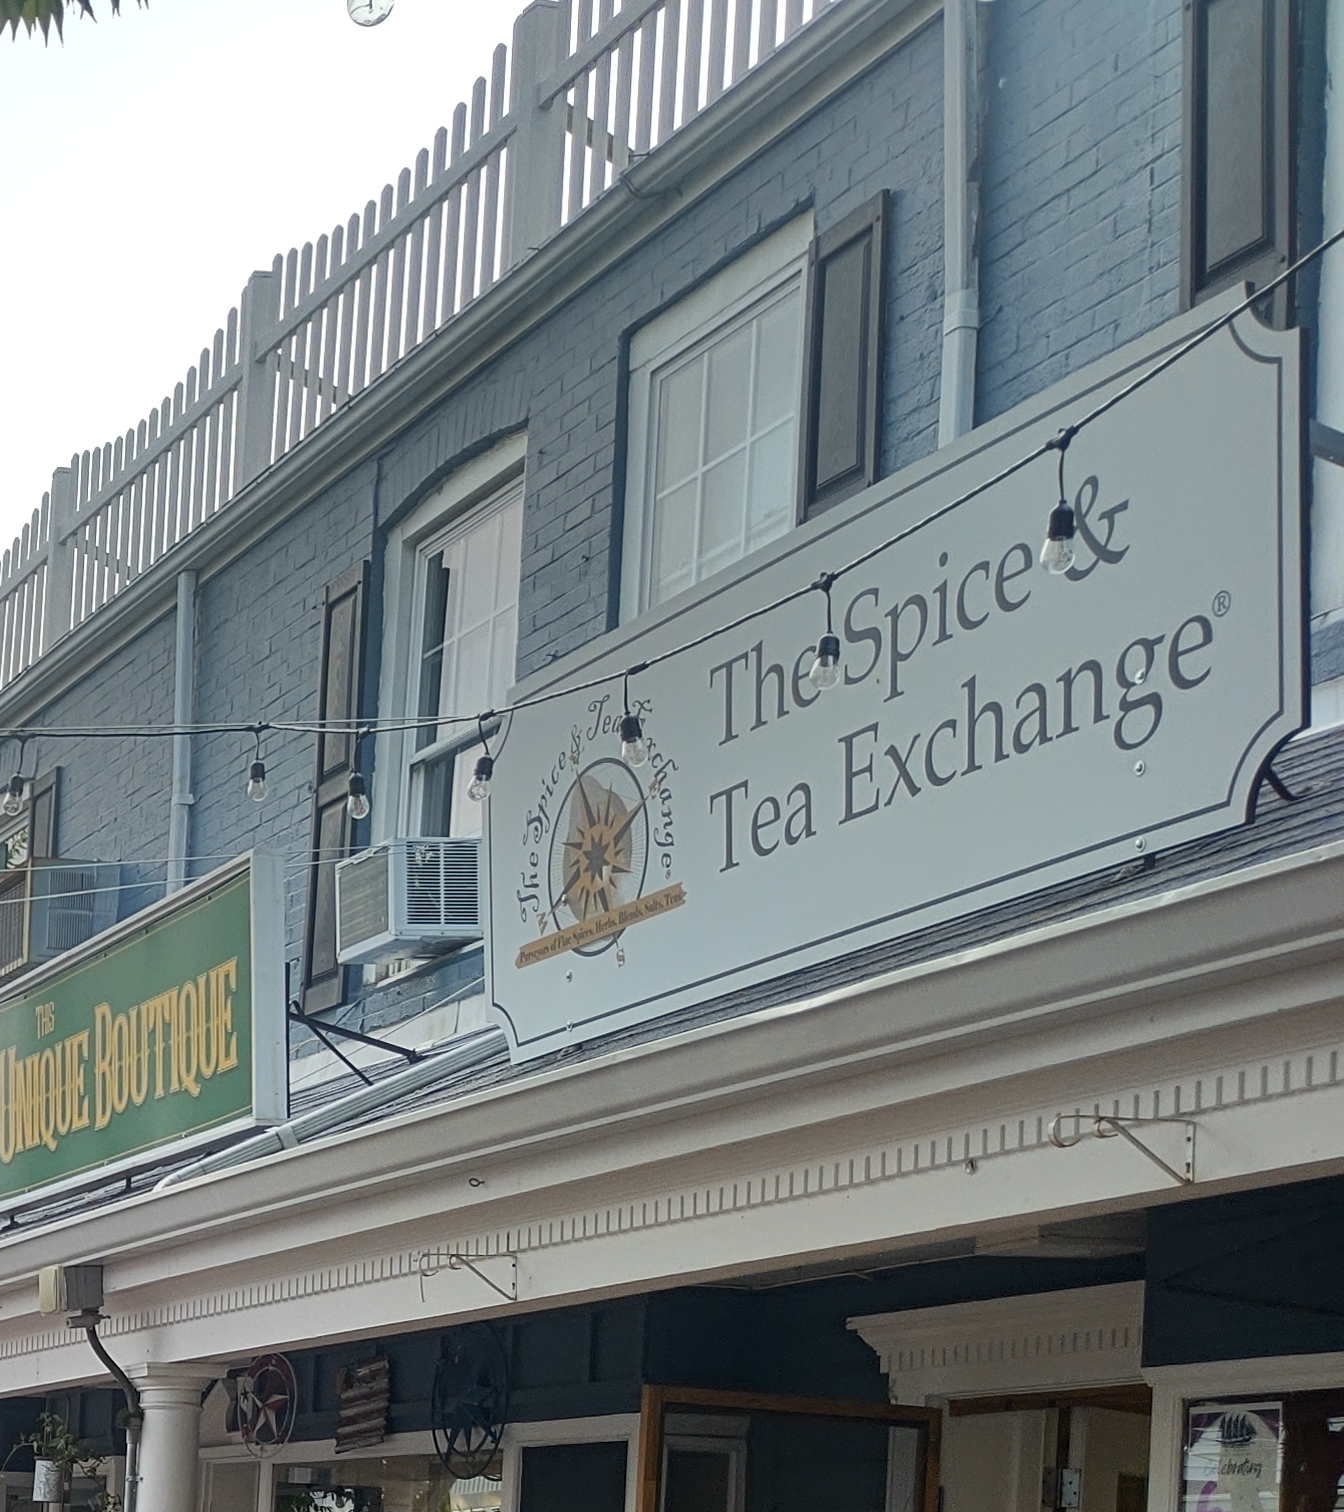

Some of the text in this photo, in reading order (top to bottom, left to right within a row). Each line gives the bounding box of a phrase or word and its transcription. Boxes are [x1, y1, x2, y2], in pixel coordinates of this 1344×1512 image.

[709, 475, 1130, 746] The Spice &
[523, 751, 567, 846] Spice
[709, 779, 817, 873] Tea
[517, 851, 540, 923] The
[35, 1001, 55, 1039] THIS
[94, 955, 239, 1131] BOUTIQUE
